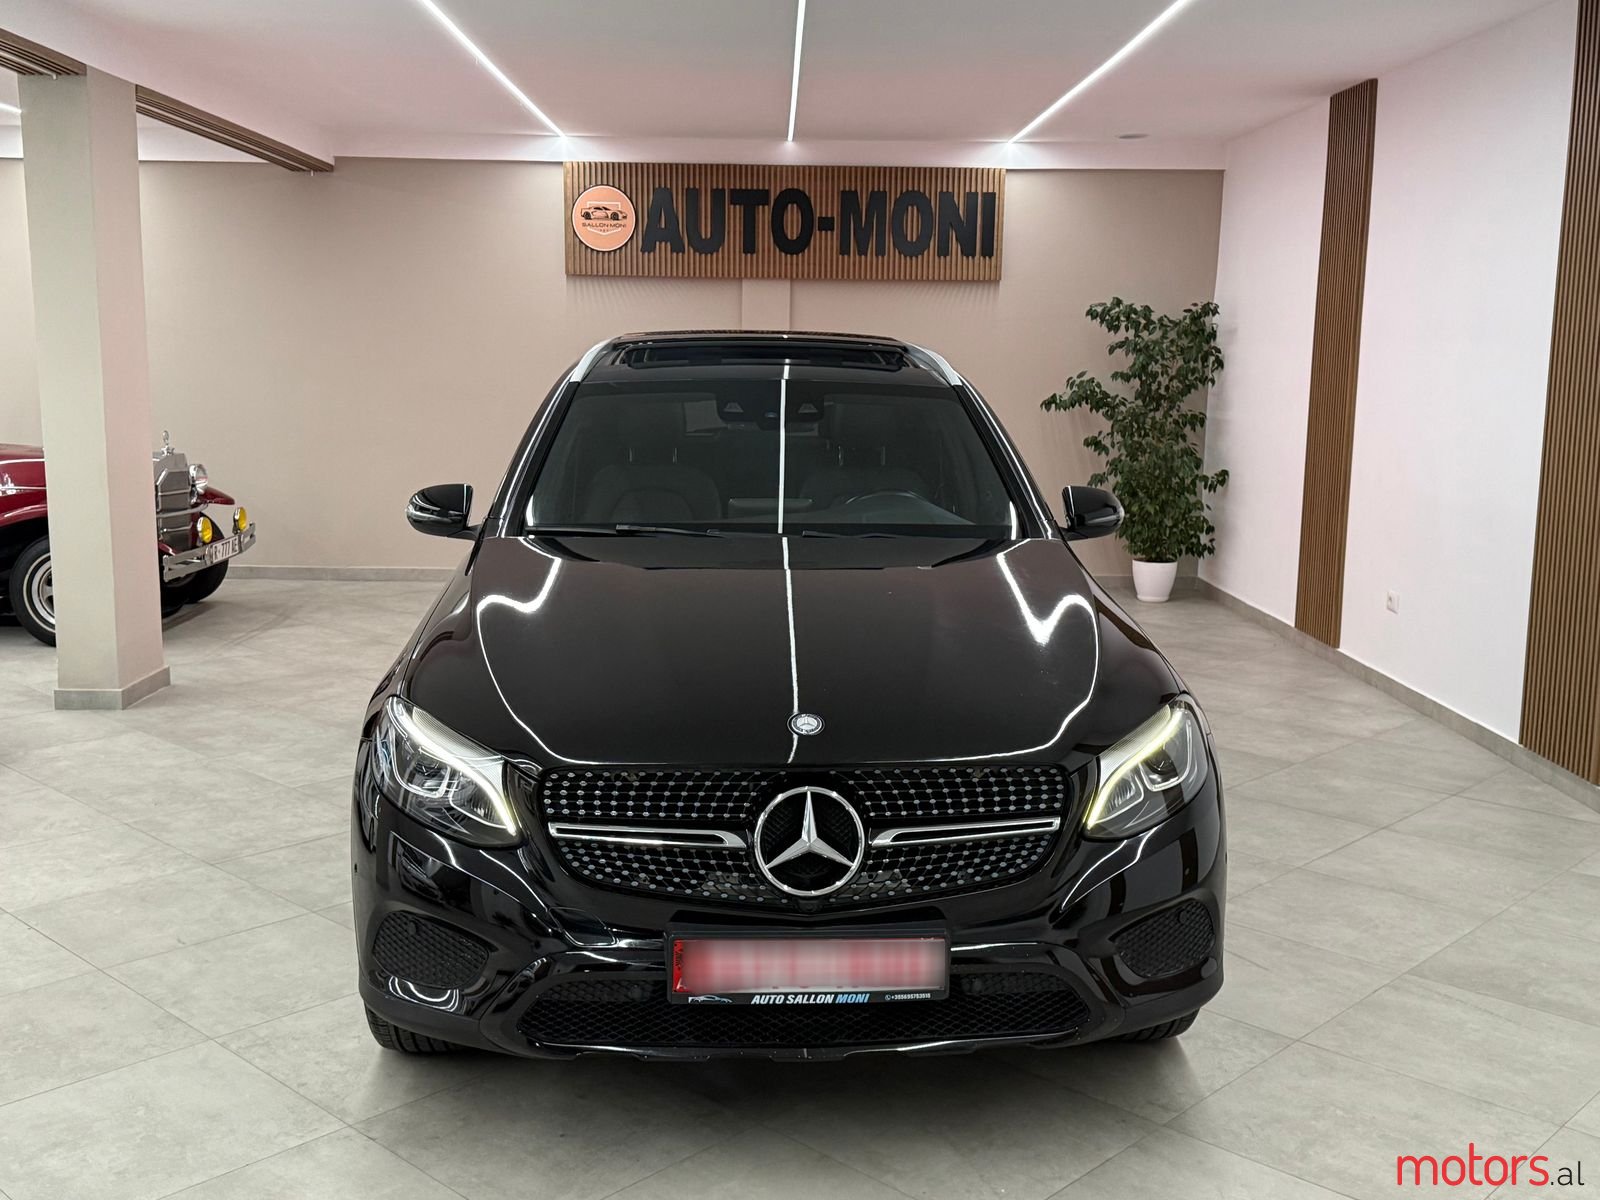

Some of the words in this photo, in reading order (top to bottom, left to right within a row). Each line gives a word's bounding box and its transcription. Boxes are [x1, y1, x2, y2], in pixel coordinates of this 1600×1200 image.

[641, 187, 997, 259] AUTO-MONI
[751, 994, 785, 1005] AUTO
[786, 994, 835, 1004] SALLON
[835, 993, 870, 1004] MONI
